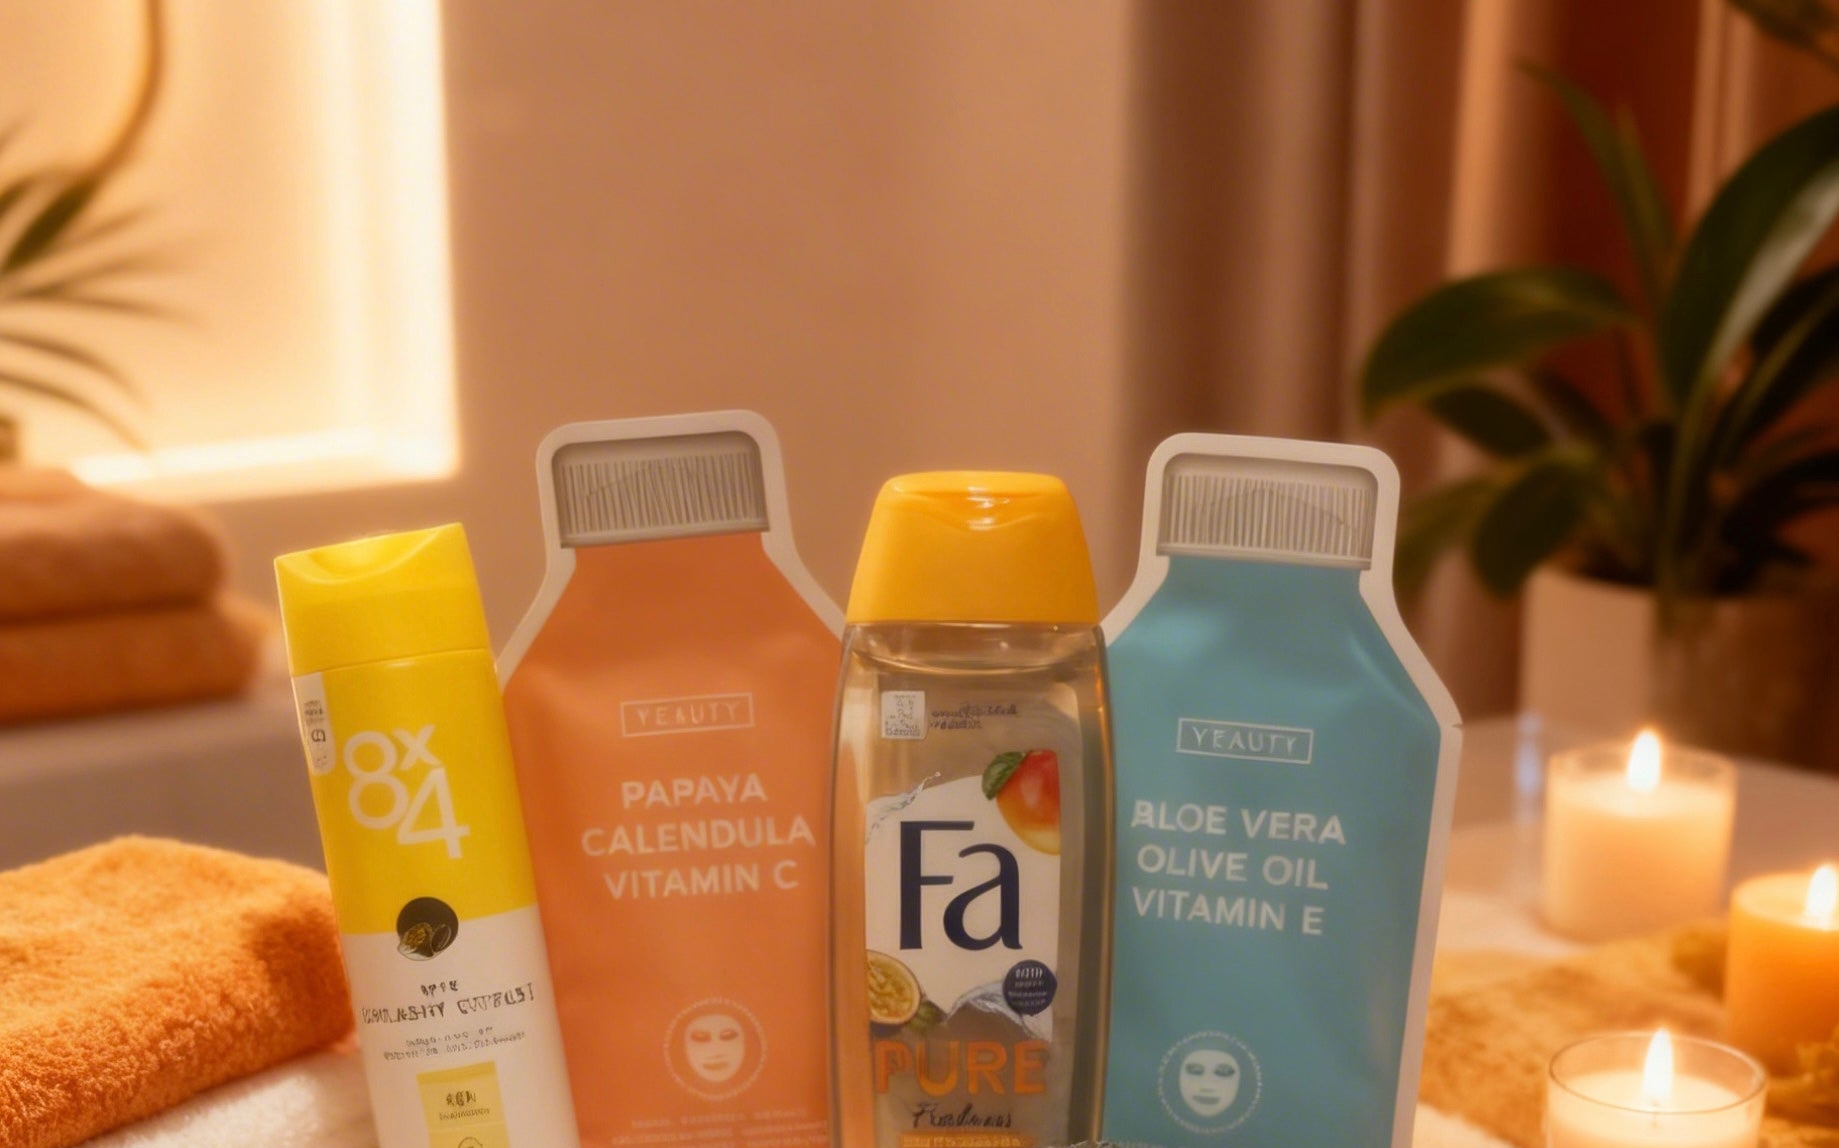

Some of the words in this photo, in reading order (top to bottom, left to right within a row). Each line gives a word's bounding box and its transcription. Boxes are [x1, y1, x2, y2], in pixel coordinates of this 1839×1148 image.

[1192, 726, 1297, 756] YEAUTY
[621, 773, 768, 809] PAPAYA
[581, 814, 817, 856] CALENDULA
[1240, 808, 1347, 845] VERA
[603, 863, 760, 900] VITAMIN
[773, 860, 799, 890] C
[900, 820, 1023, 951] Fa
[1136, 844, 1248, 882] OLIVE
[1262, 855, 1329, 890] OIL
[1132, 886, 1286, 931] VITAMIN
[1302, 905, 1325, 935] E
[874, 1040, 1047, 1097] PURE
